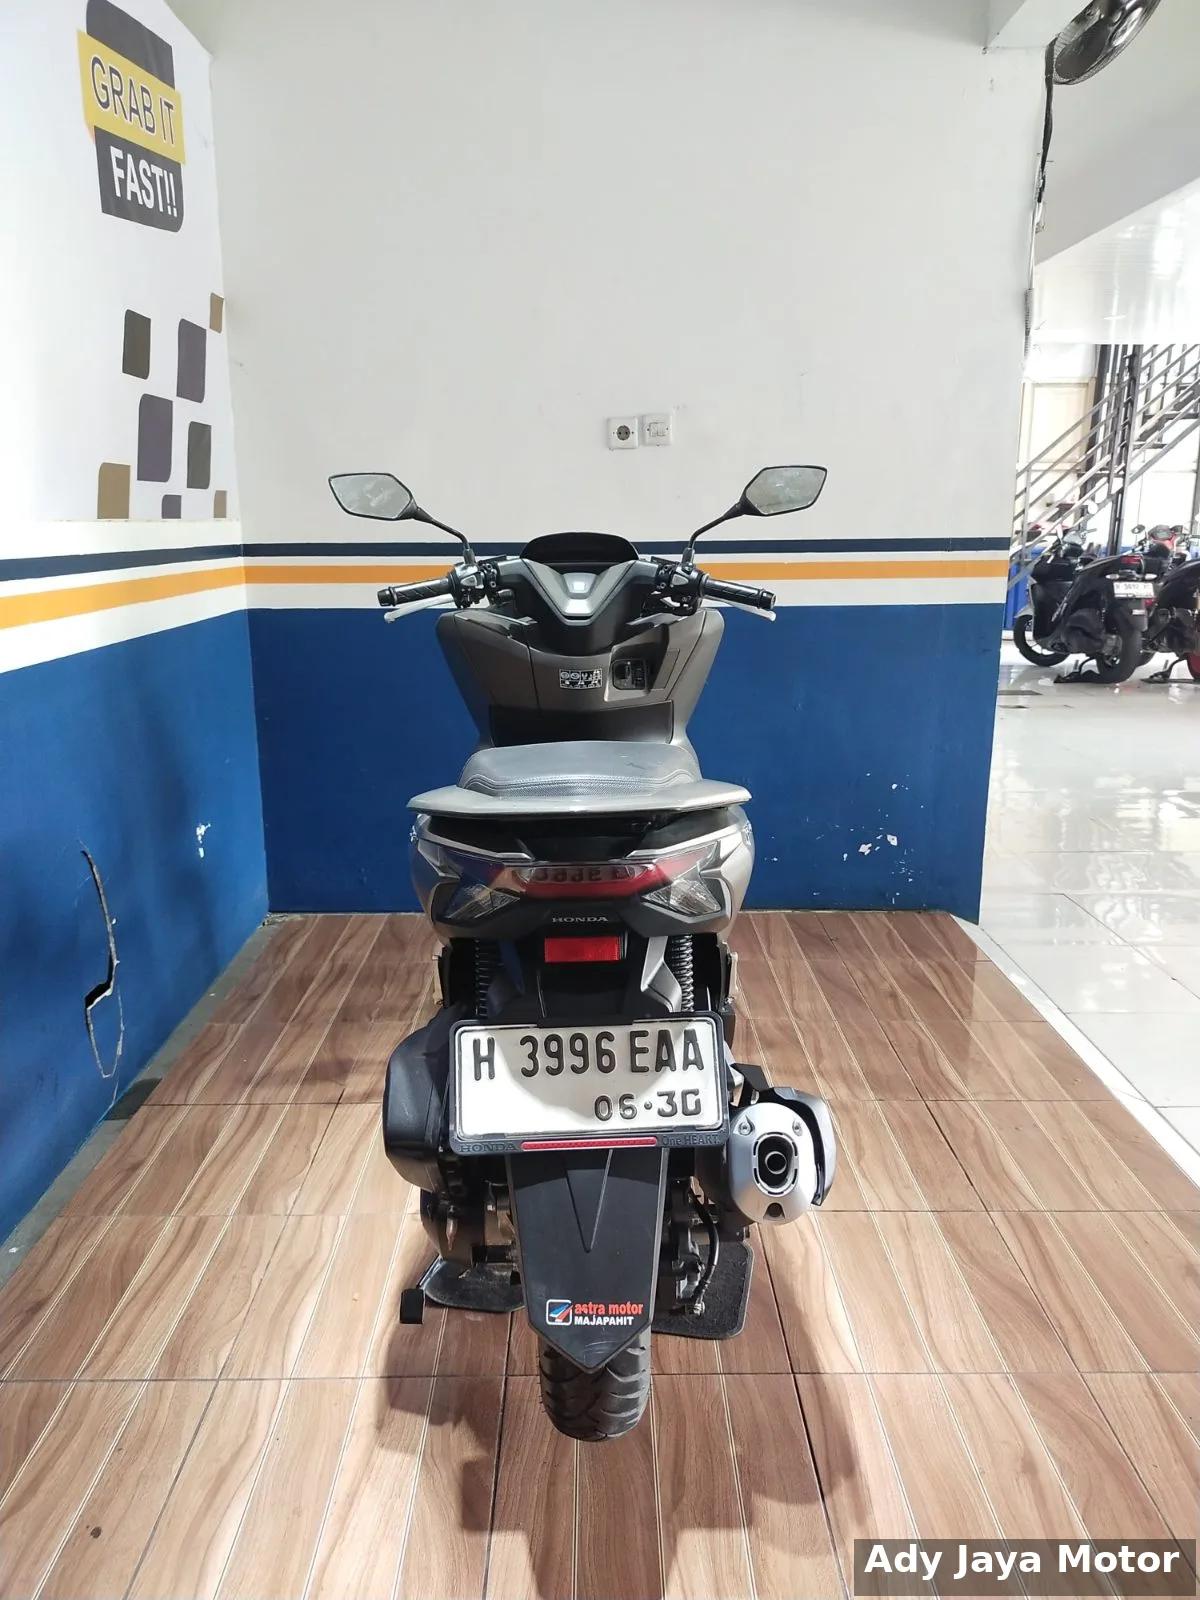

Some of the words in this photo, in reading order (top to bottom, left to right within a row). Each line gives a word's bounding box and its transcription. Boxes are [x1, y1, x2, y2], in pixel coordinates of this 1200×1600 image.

[91, 56, 156, 134] GRAB
[159, 97, 175, 145] IT
[110, 145, 178, 218] FAST!!
[472, 1036, 496, 1081] H
[519, 1031, 616, 1078] 3996
[629, 1028, 704, 1073] EAA
[662, 1134, 681, 1146] One
[459, 1142, 517, 1153] HONDA
[574, 1301, 606, 1315] astra
[608, 1301, 644, 1315] motor
[574, 1315, 635, 1326] MAJAPAHIT
